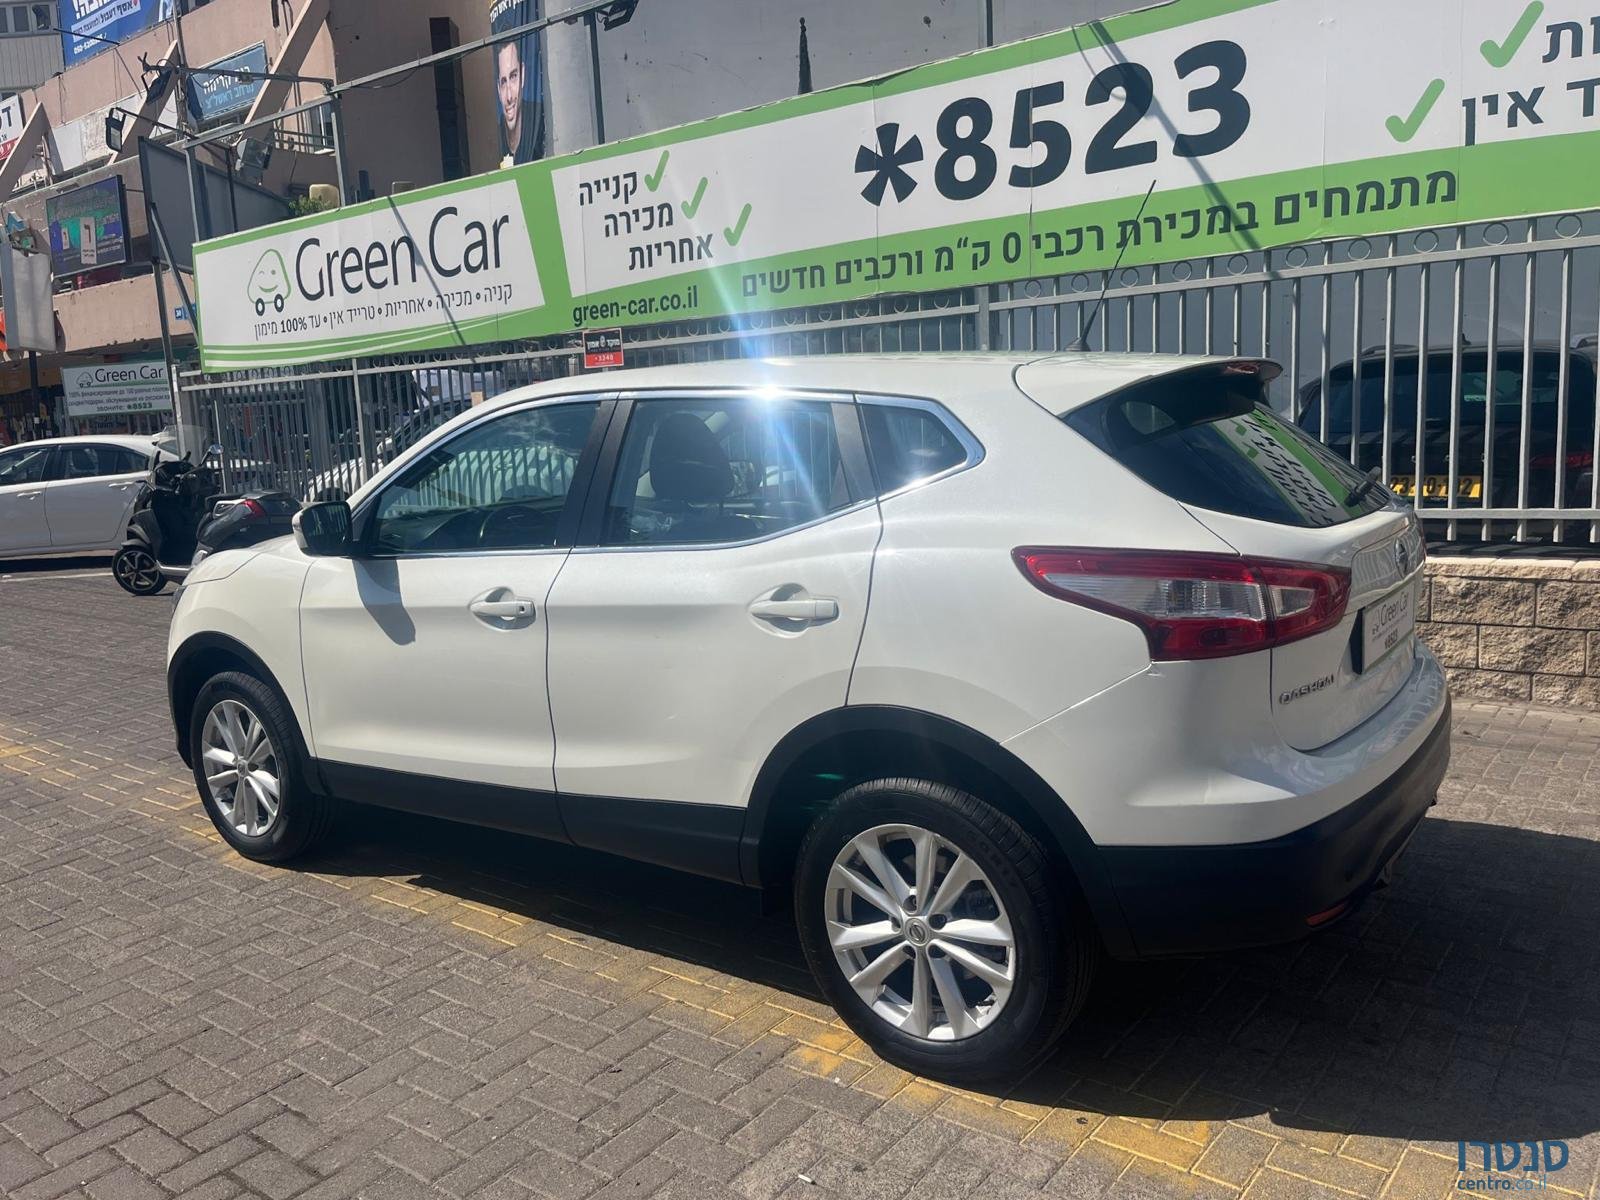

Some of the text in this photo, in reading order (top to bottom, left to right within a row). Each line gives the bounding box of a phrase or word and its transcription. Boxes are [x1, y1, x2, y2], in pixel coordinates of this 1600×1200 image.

[1462, 86, 1545, 146] אין
[579, 171, 637, 206] קנייה
[1275, 170, 1457, 225] מתמחים
[604, 202, 674, 237] מכירה
[1116, 200, 1258, 249] במכירת
[295, 206, 509, 301] Green Car
[629, 233, 714, 270] אחריות
[1002, 231, 1021, 264] 0
[1034, 224, 1104, 259] רכבי
[743, 265, 825, 297] חדשים
[836, 249, 923, 285] ורכבים
[254, 283, 513, 341] קניה מכירה אחריות טרייד אין עד 100% מימון
[572, 285, 698, 327] green-car.co.il
[95, 365, 164, 383] Green Car
